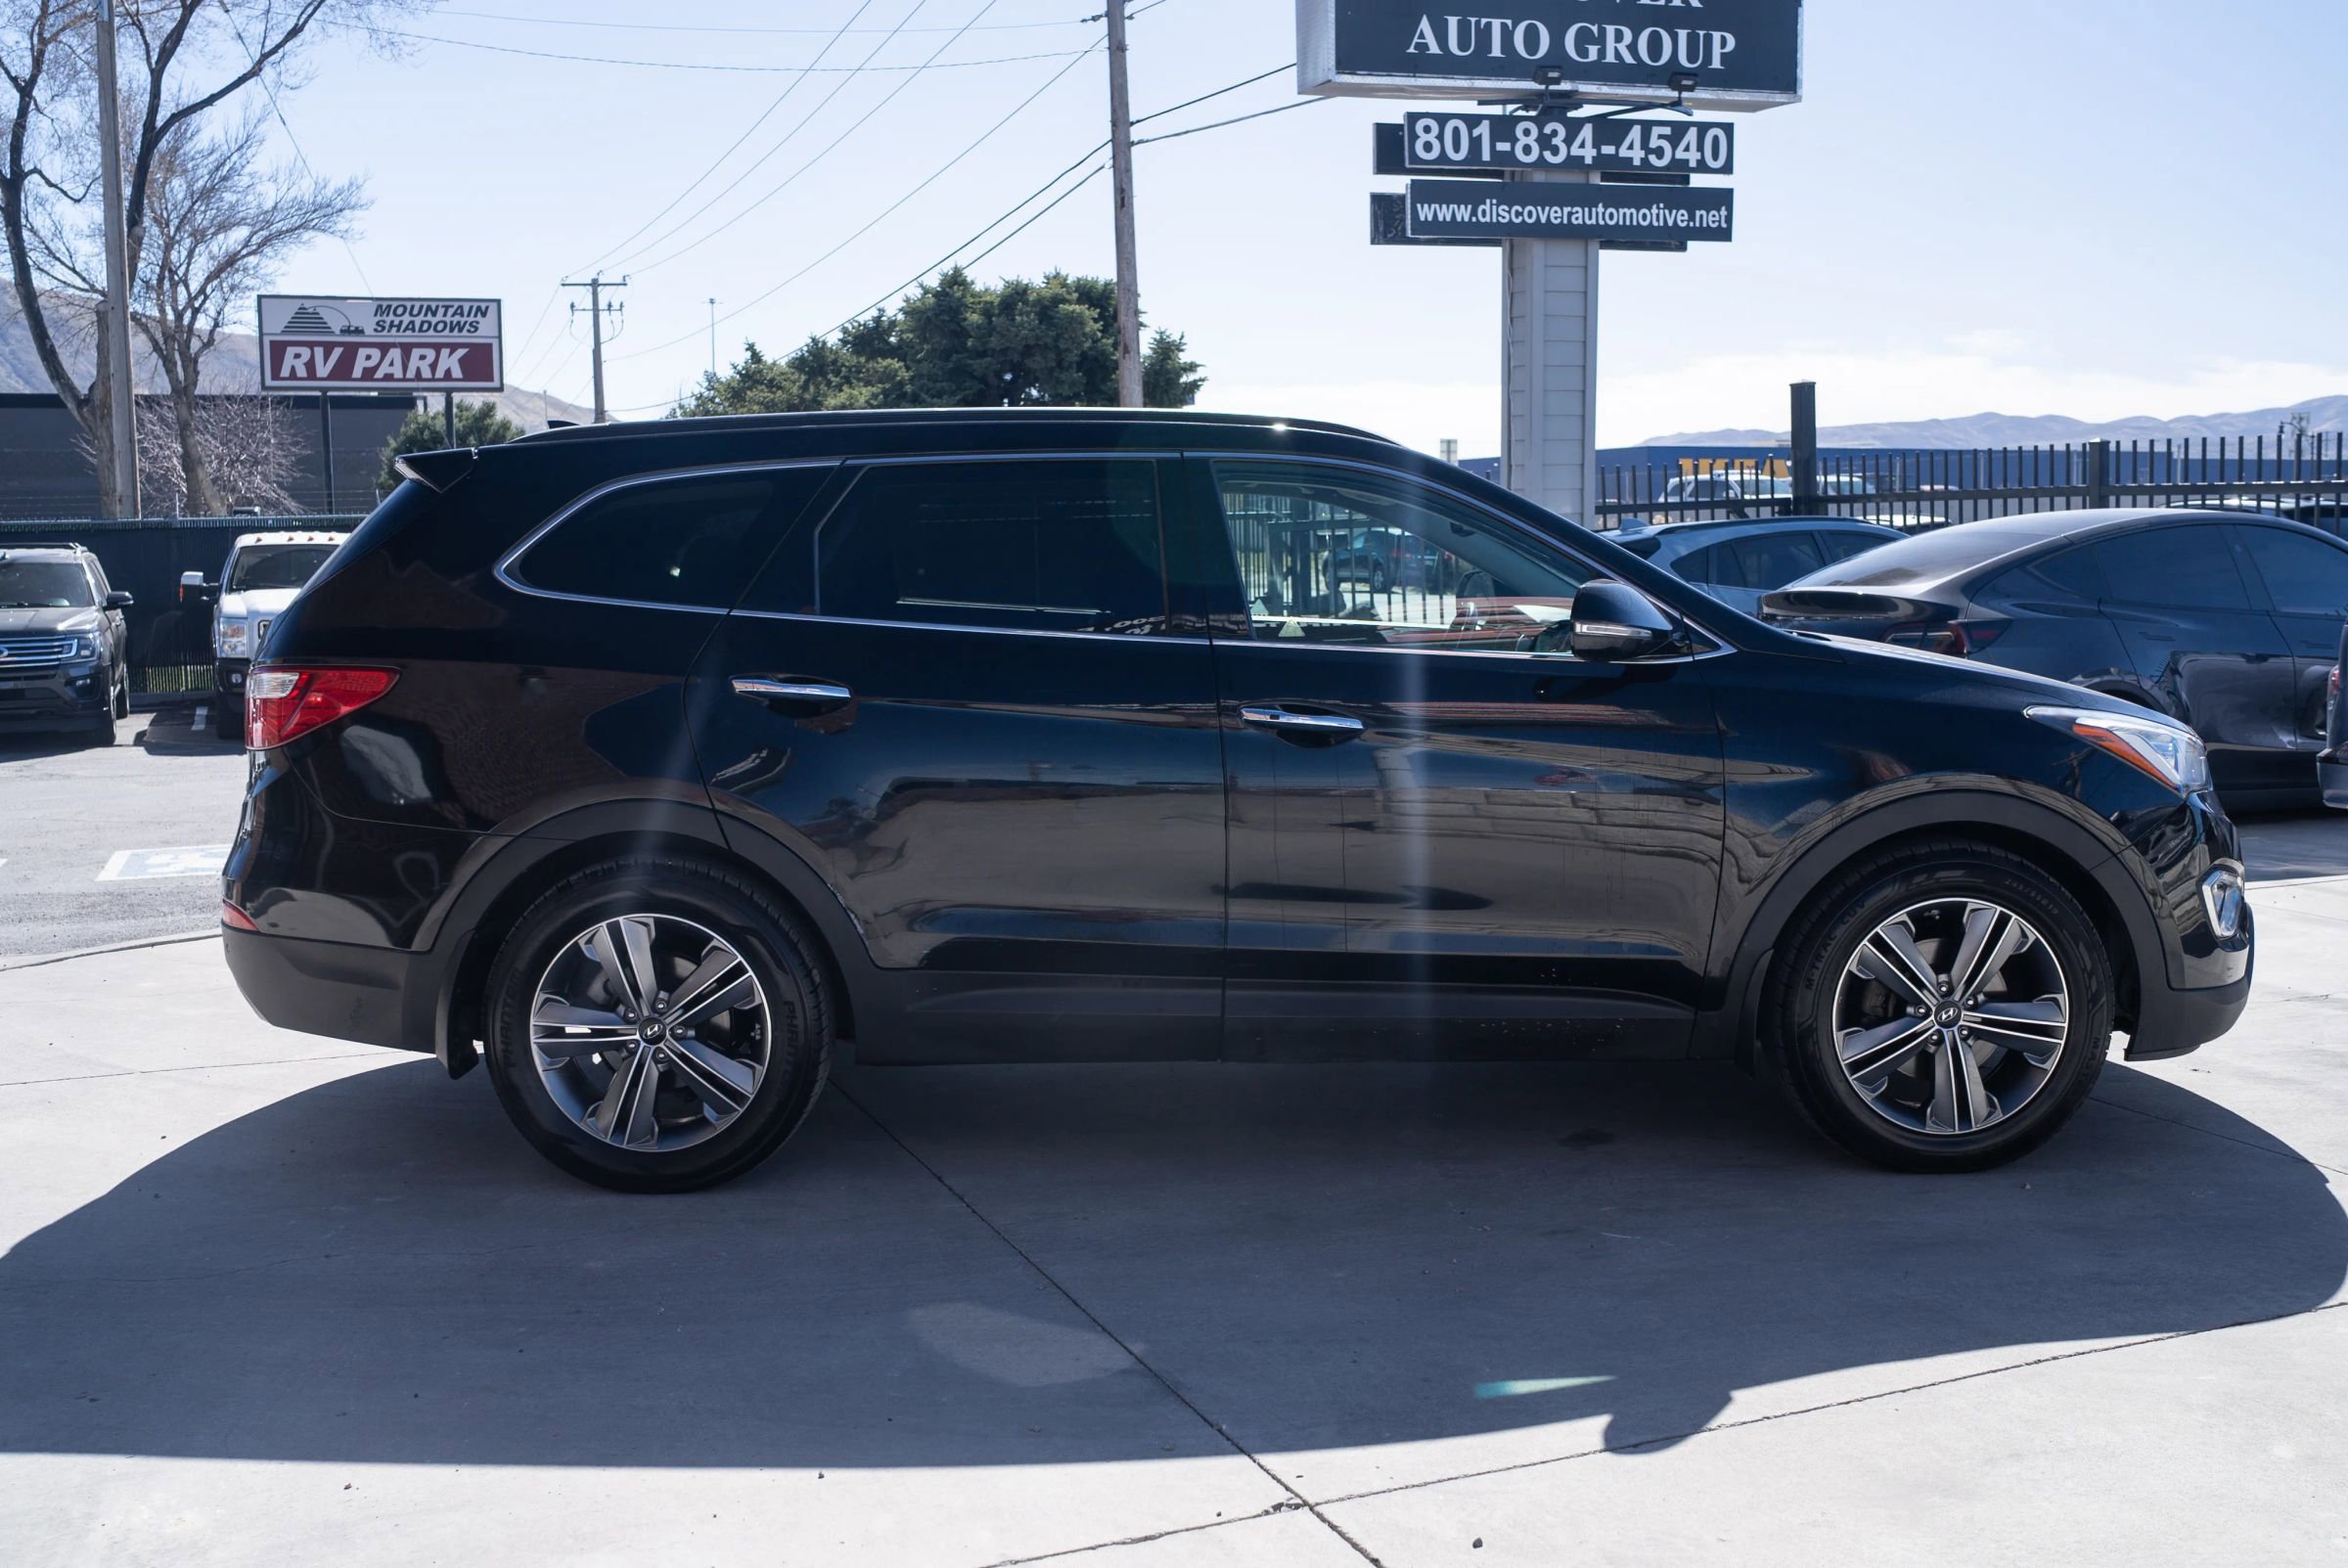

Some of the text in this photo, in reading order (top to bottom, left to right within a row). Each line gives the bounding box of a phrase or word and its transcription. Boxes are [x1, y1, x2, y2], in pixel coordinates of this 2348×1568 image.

[1405, 14, 1736, 69] AUTO GROUP
[1415, 117, 1729, 169] 801-834-4540
[1417, 199, 1728, 229] www.discoverautomotive.net
[373, 303, 489, 319] MOUNTAIN
[373, 319, 480, 335] SHADOWS
[279, 345, 470, 380] RV PARK
